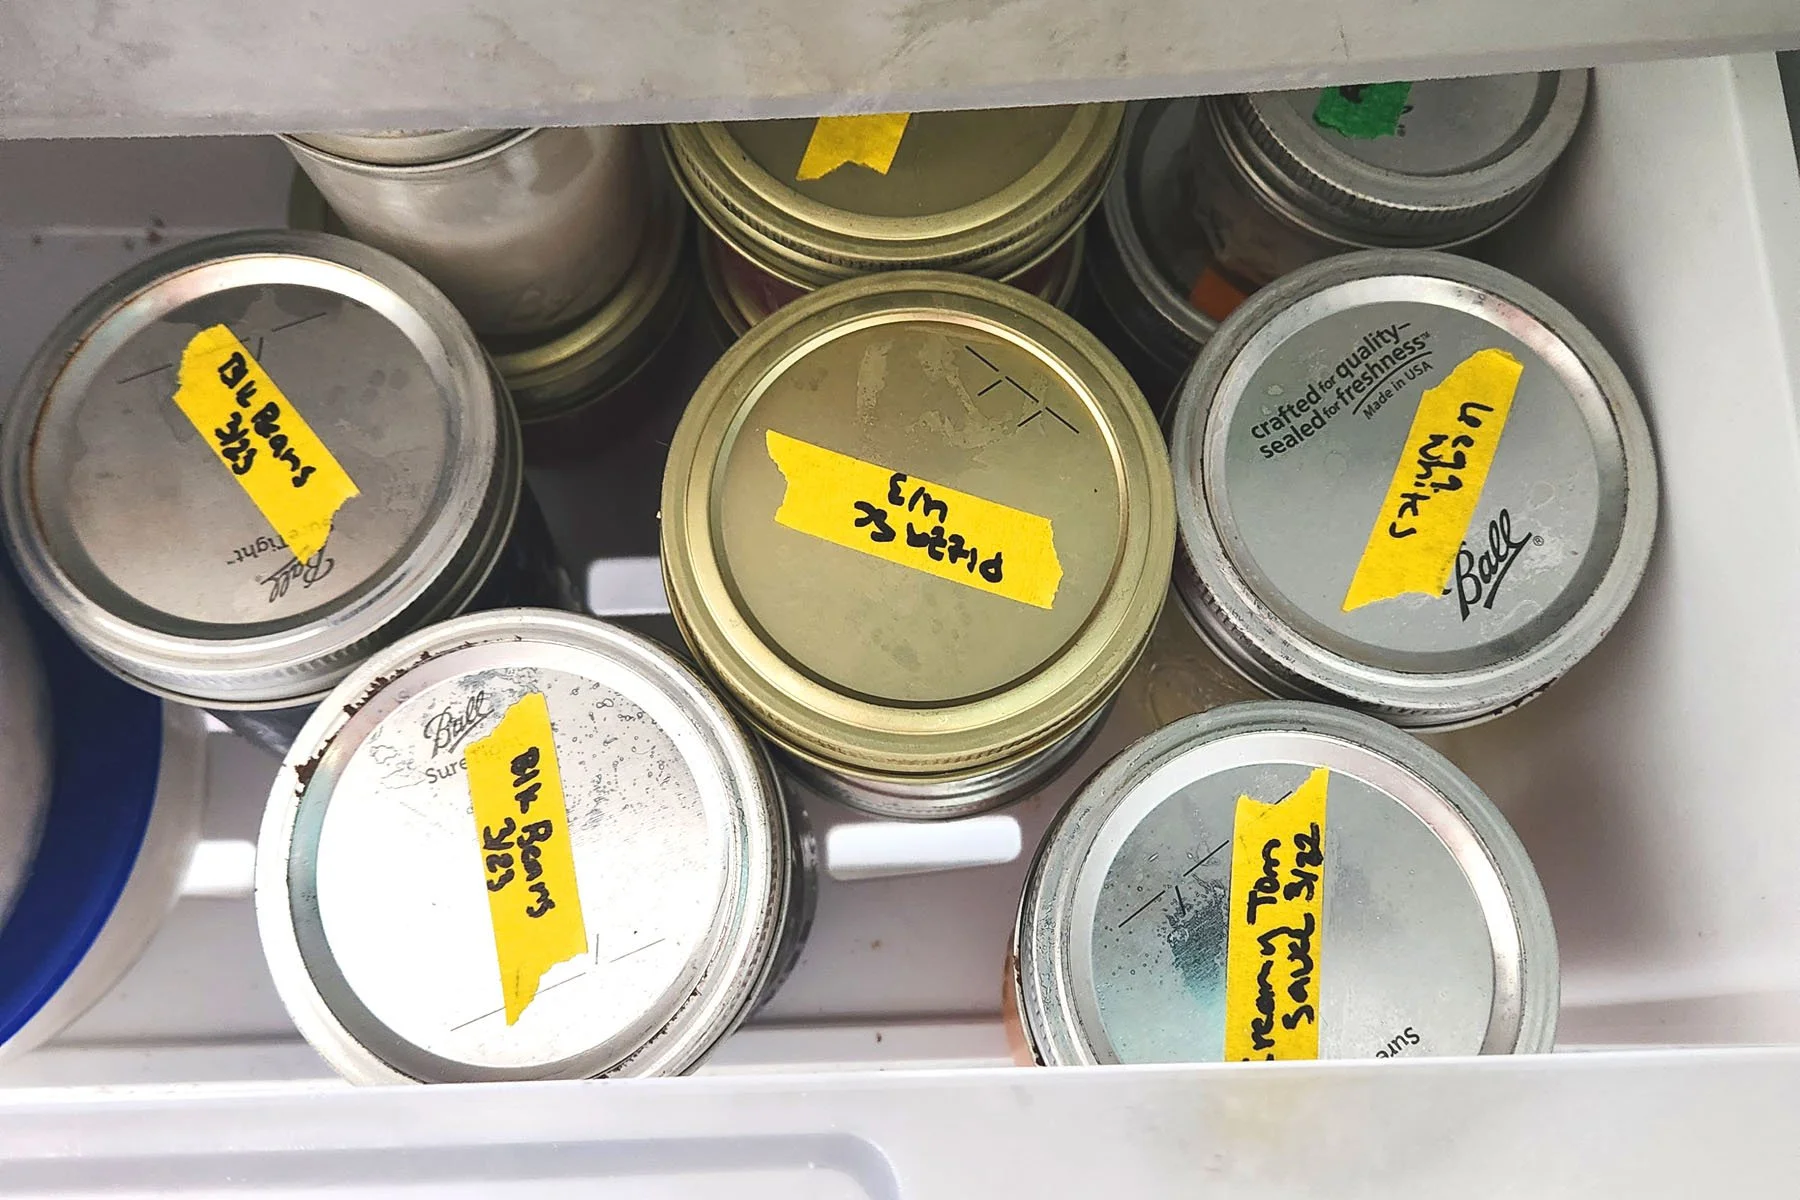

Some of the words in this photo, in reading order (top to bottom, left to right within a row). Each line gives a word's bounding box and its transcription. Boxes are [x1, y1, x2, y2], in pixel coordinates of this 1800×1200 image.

[1251, 383, 1323, 440] crafted
[1317, 374, 1338, 394] for
[1363, 390, 1395, 421] Made
[1391, 378, 1407, 392] in
[1404, 360, 1434, 381] USA
[251, 401, 316, 488] Beans
[1258, 408, 1328, 460] sealed
[1322, 400, 1342, 419] for
[1433, 434, 1475, 493] egg
[424, 691, 495, 757] Ball
[516, 819, 555, 918] Beans
[1246, 838, 1282, 925] Tom
[1282, 822, 1324, 901] 3/22
